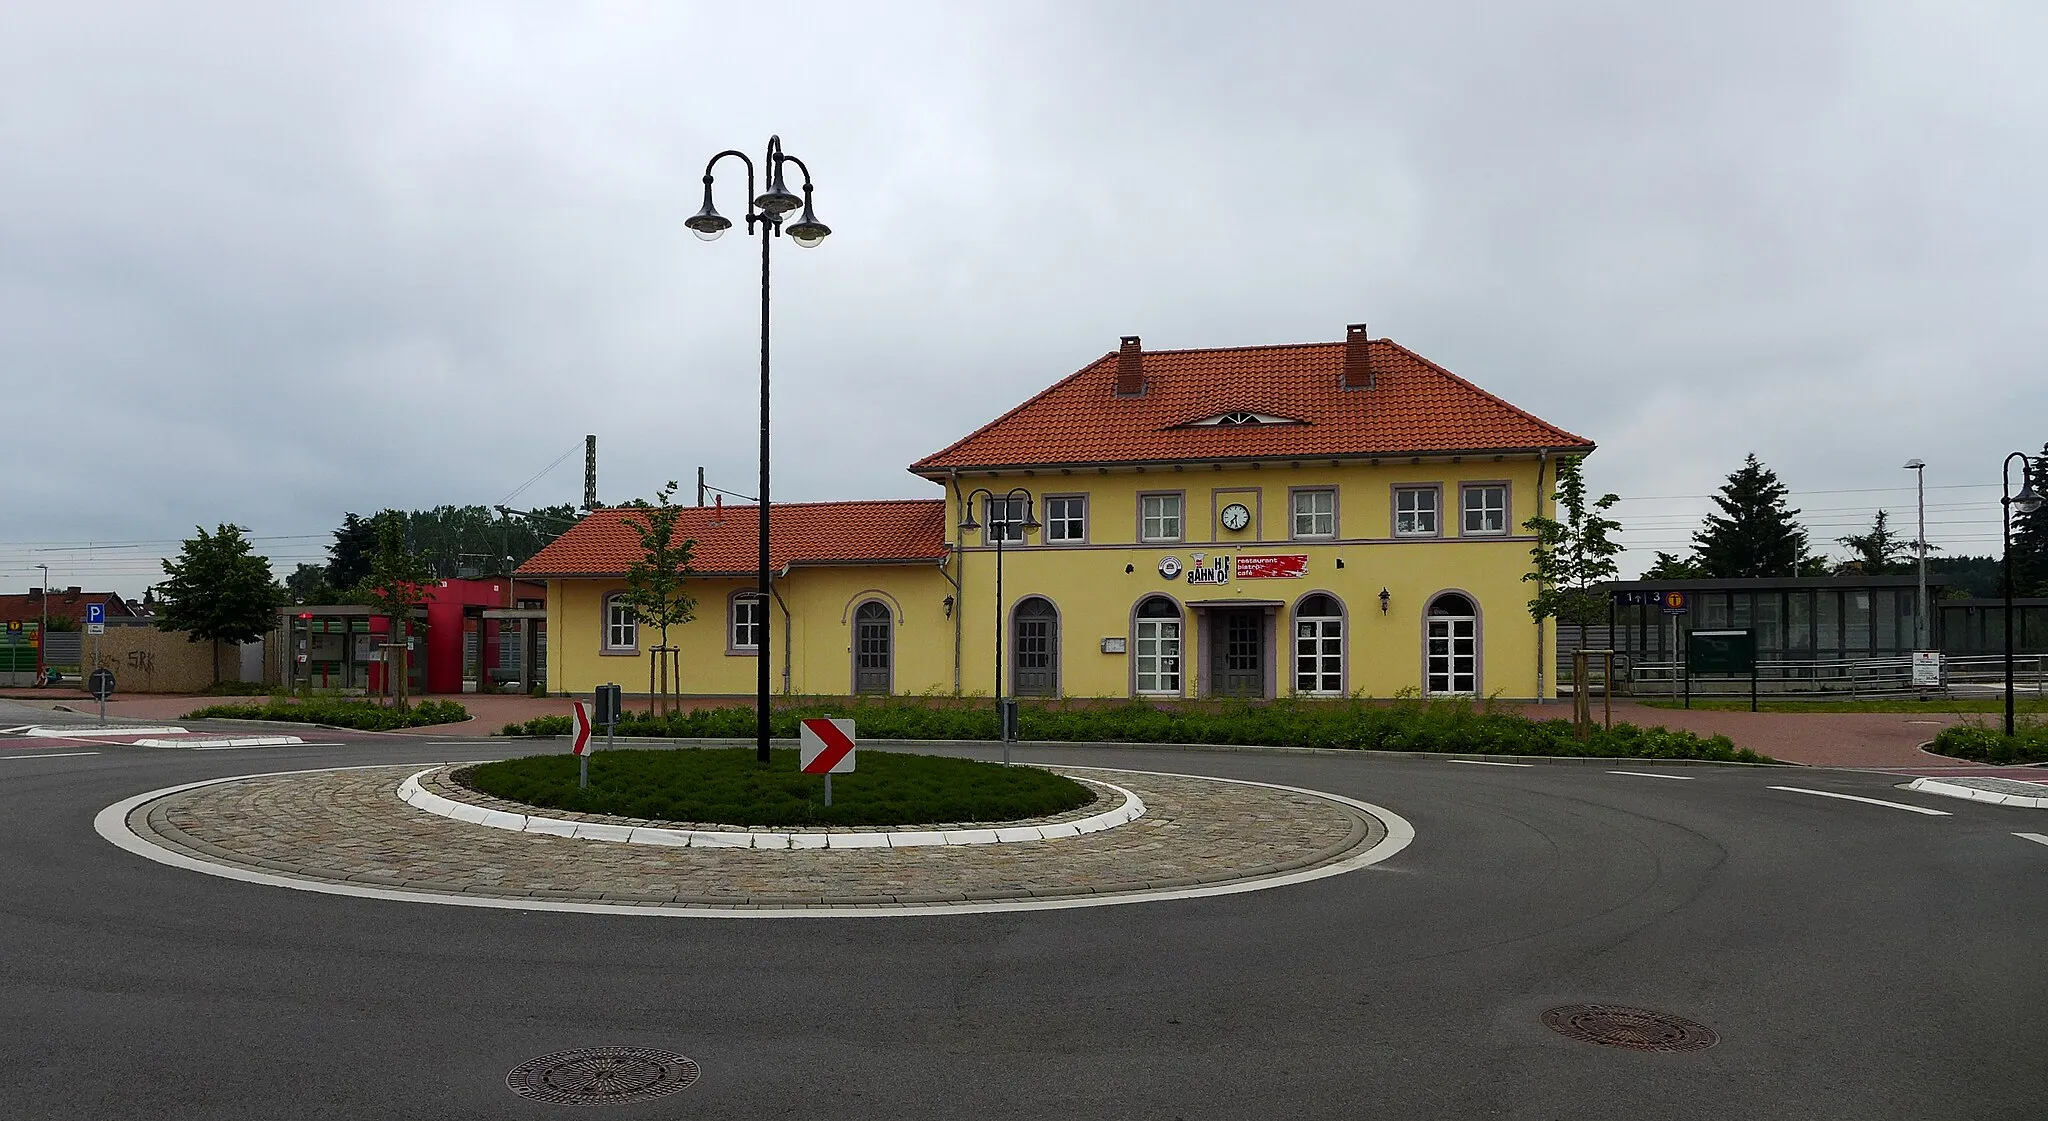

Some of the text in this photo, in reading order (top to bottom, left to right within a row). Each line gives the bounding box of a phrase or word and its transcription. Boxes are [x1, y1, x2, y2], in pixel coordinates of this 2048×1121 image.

[1626, 591, 1661, 602] 1 3
[90, 606, 101, 622] P
